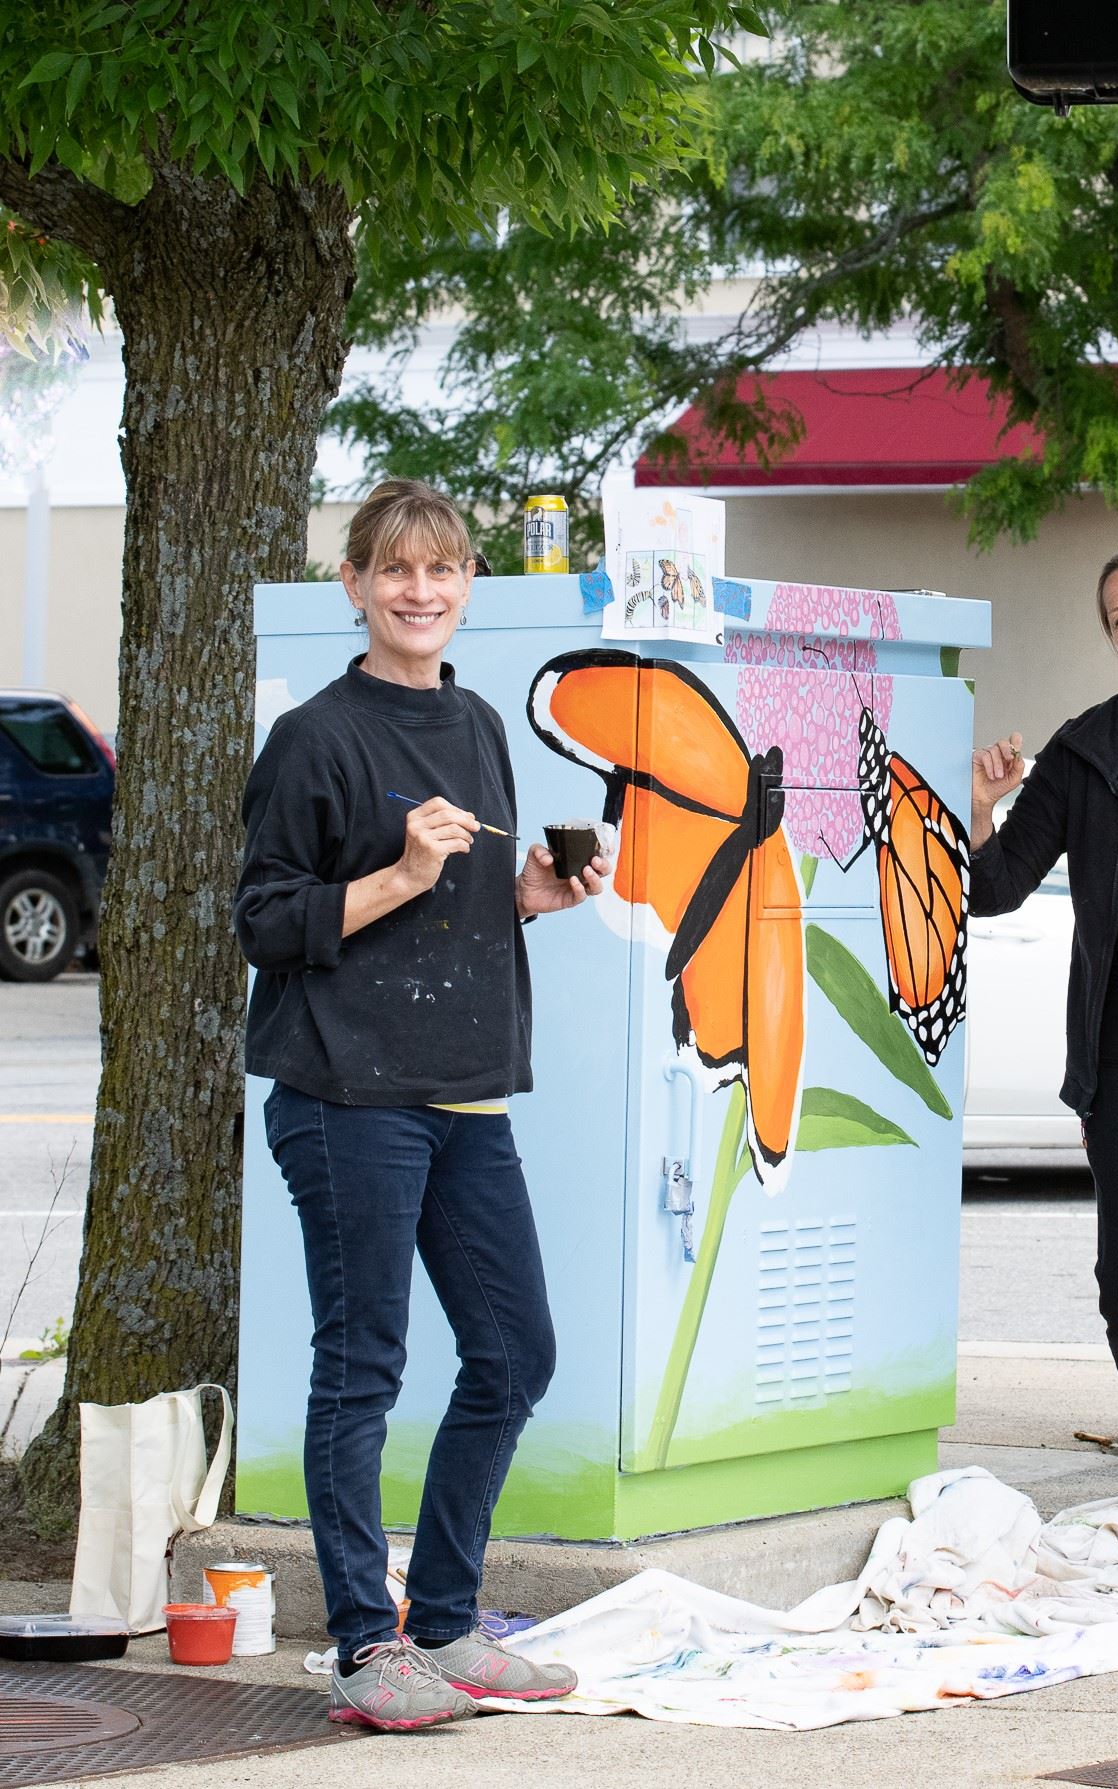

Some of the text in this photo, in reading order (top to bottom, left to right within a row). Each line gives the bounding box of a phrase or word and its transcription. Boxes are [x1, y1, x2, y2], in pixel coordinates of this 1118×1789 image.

[527, 522, 552, 538] POLAR
[466, 1653, 509, 1684] N
[362, 1684, 395, 1714] N
